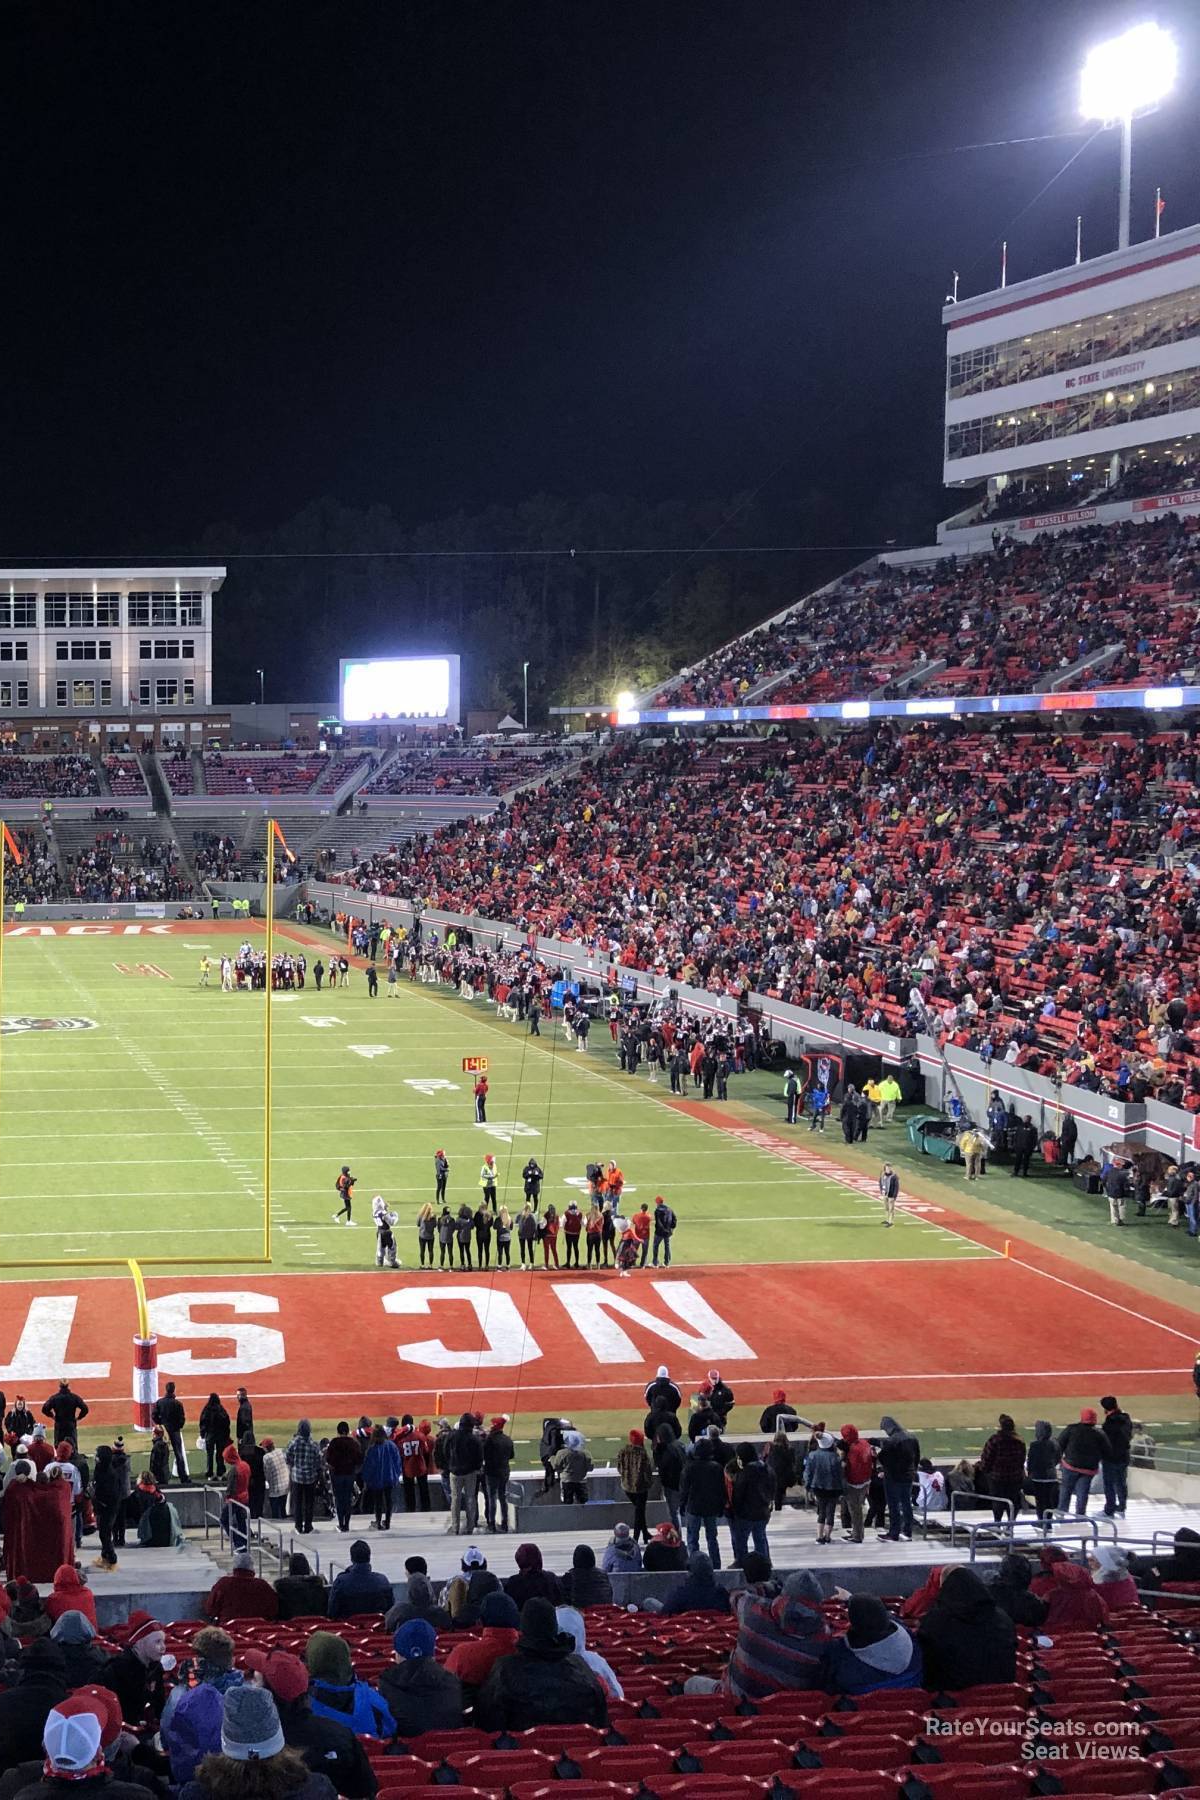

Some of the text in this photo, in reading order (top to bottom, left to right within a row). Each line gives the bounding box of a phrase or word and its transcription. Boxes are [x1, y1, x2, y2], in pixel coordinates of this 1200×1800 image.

[1078, 371, 1100, 386] STATE
[1102, 360, 1146, 380] UNIVERSITY
[1067, 508, 1096, 523] WILSON
[465, 1058, 488, 1071] 1:48
[1108, 1105, 1119, 1119] 23
[381, 1280, 759, 1369] NC
[402, 1440, 420, 1457] 87
